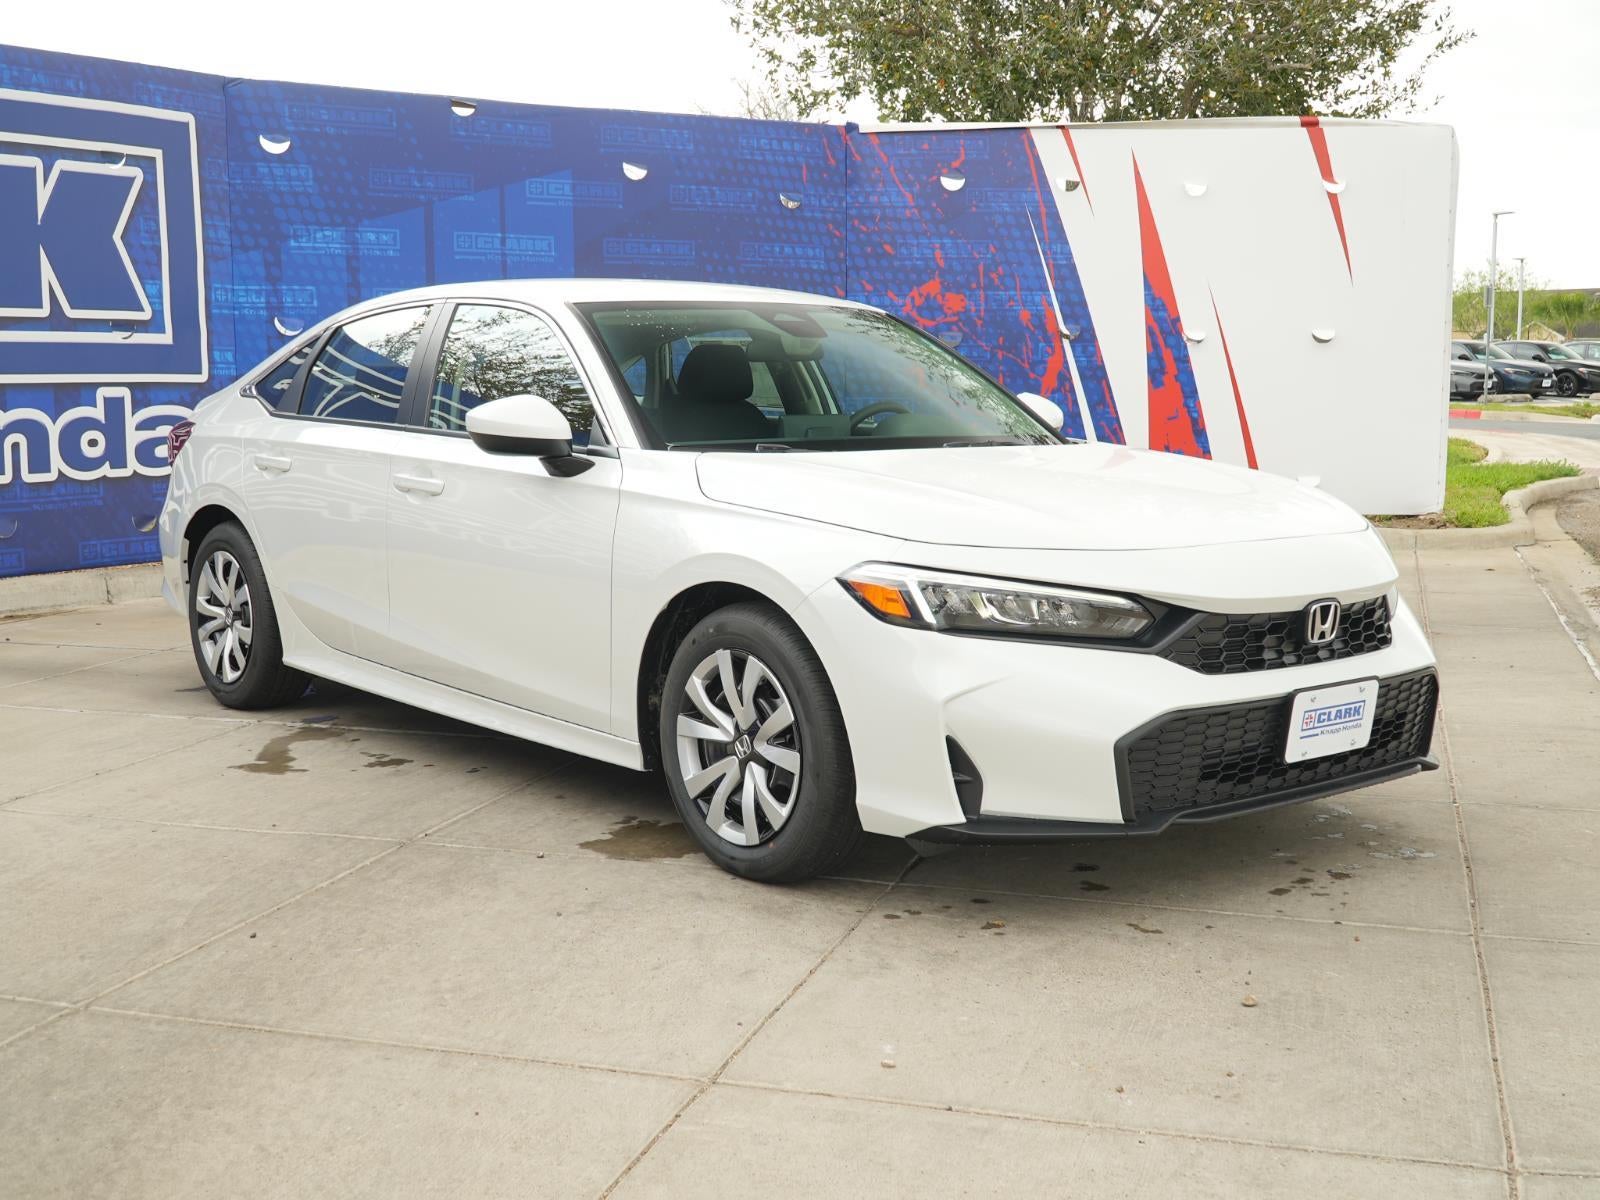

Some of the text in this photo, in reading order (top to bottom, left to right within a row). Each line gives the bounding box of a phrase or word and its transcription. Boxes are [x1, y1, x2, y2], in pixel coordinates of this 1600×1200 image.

[476, 237, 551, 251] CLARK
[1317, 705, 1362, 724] CLARK
[1342, 722, 1362, 732] Honda
